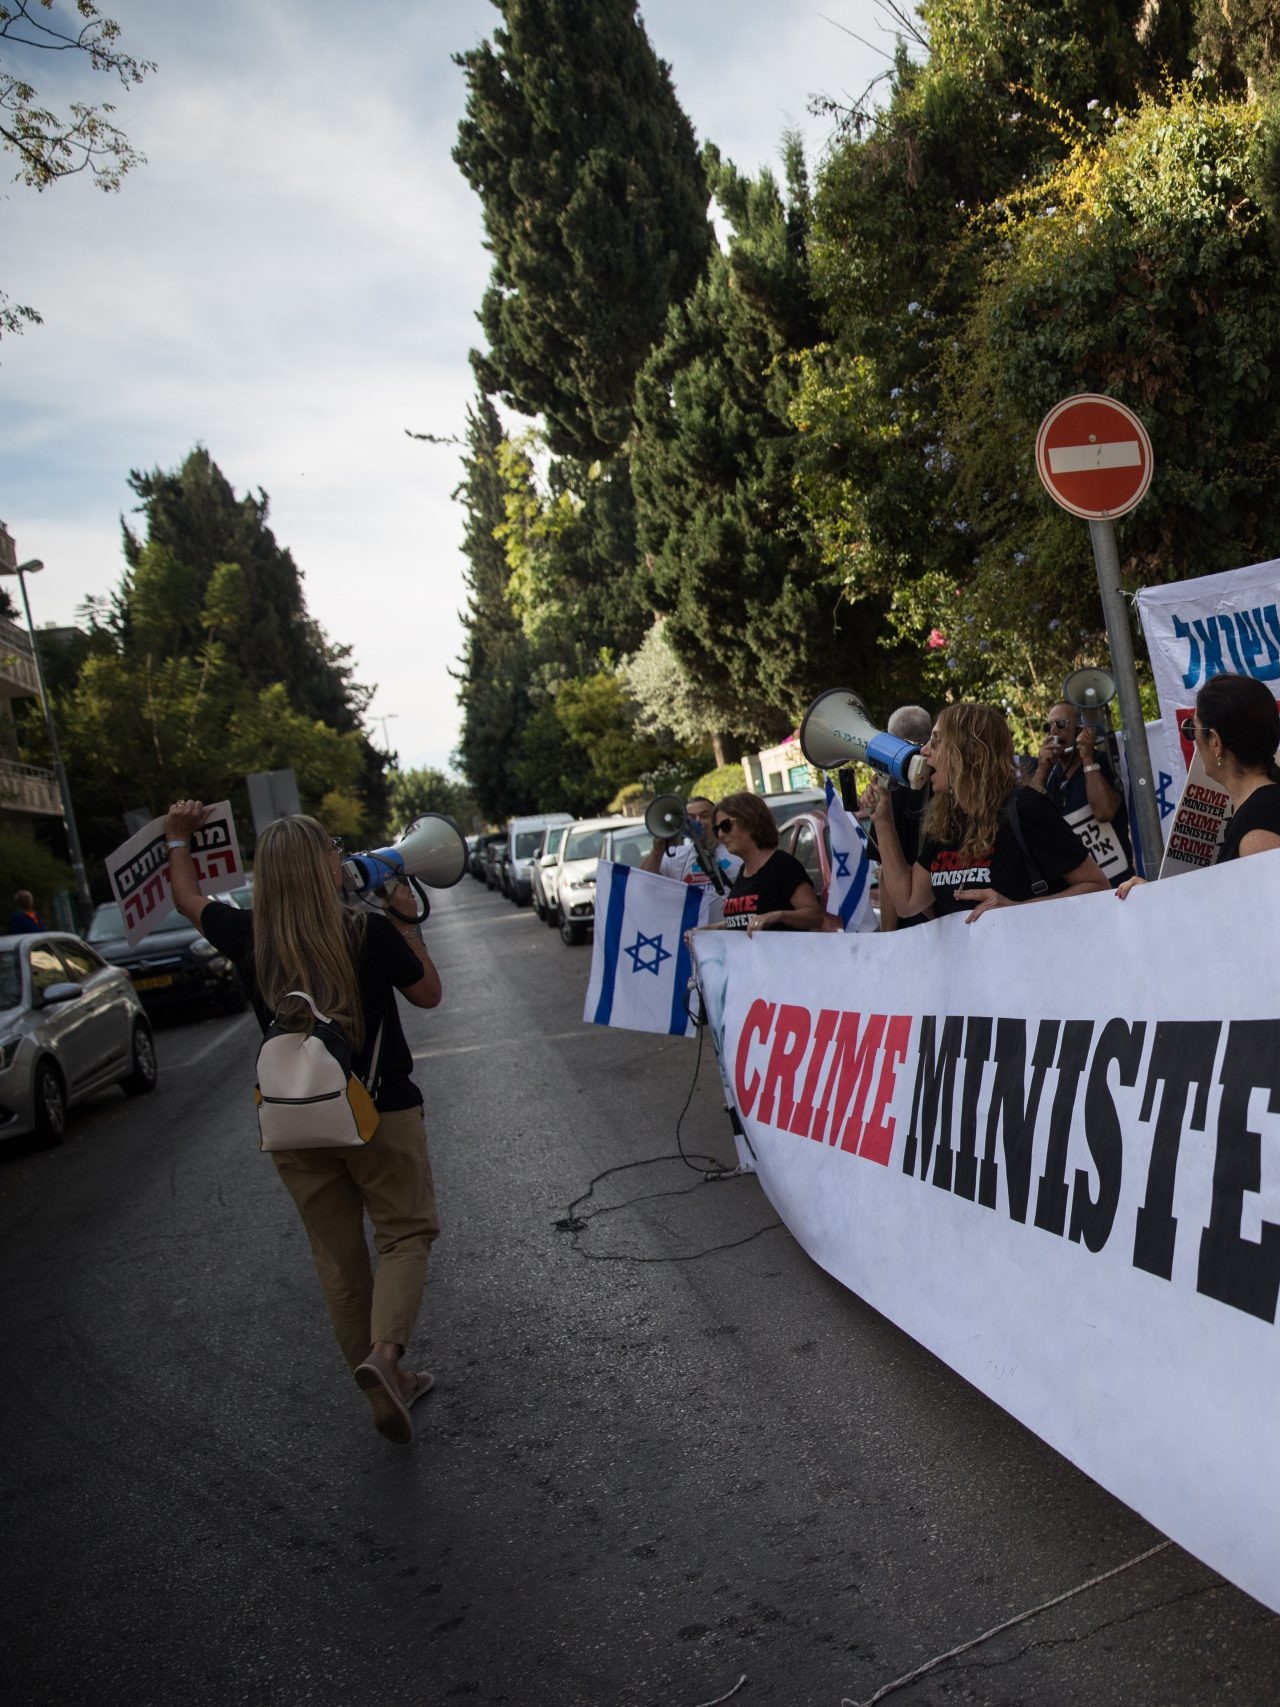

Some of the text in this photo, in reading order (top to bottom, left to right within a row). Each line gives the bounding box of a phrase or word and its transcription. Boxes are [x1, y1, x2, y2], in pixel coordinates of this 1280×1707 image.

[1181, 797, 1226, 818] MINISTER
[1185, 783, 1230, 809] CRIME
[1173, 822, 1218, 843] MINISTER
[1177, 809, 1223, 834] CRIME
[118, 826, 227, 892] מוחתים
[1169, 834, 1215, 859] CRIME
[930, 867, 991, 887] MINISTER
[735, 998, 912, 1167] CRIME
